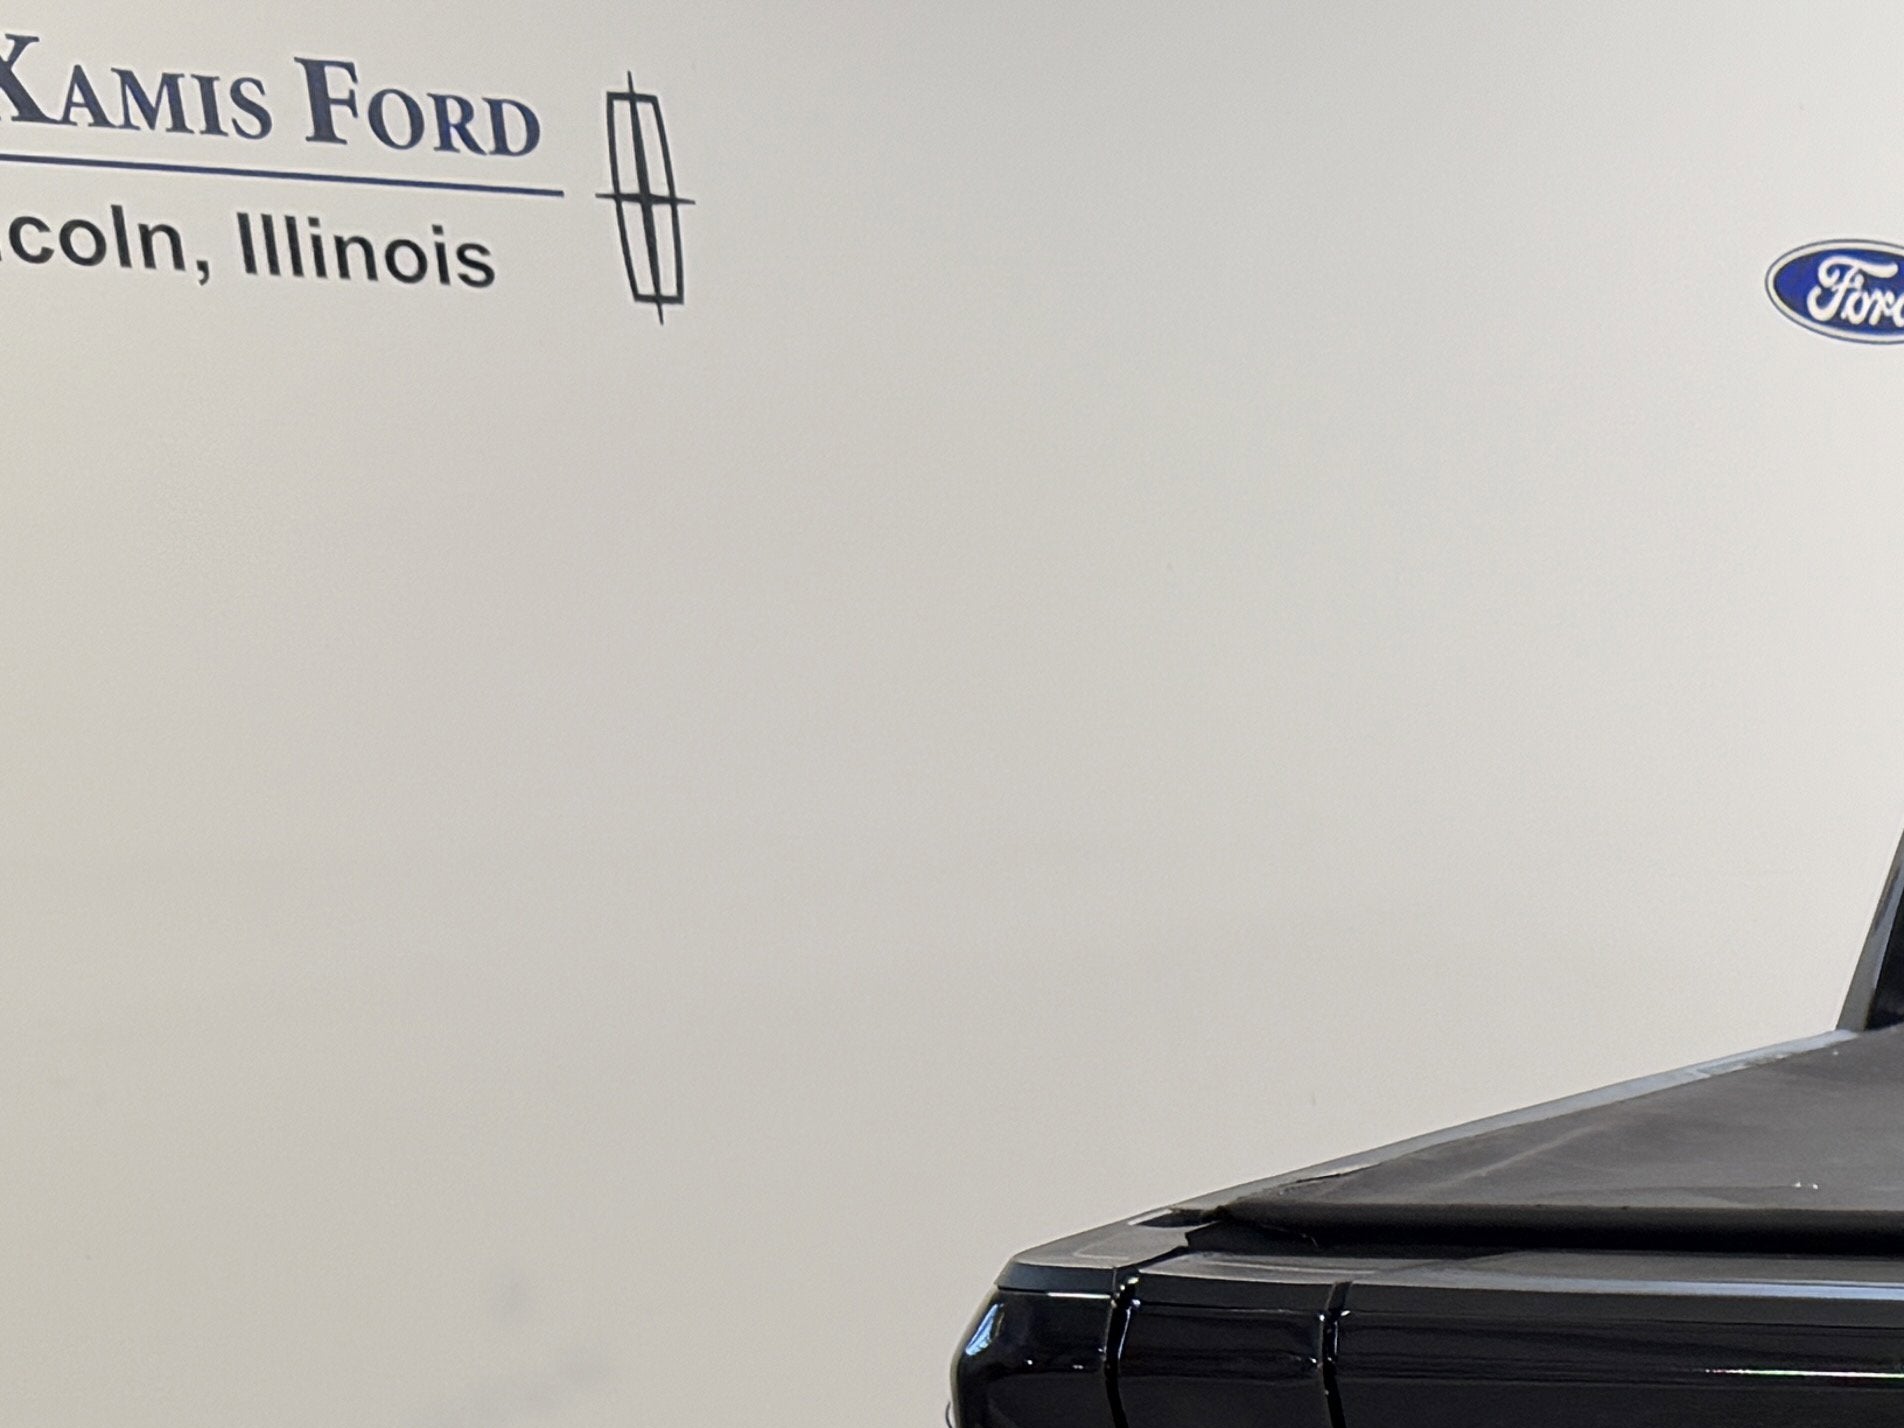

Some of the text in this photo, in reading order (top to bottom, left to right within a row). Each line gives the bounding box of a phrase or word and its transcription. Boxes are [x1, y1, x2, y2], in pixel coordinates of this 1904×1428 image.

[294, 57, 541, 157] FORD
[0, 204, 496, 289] coln, Illinois
